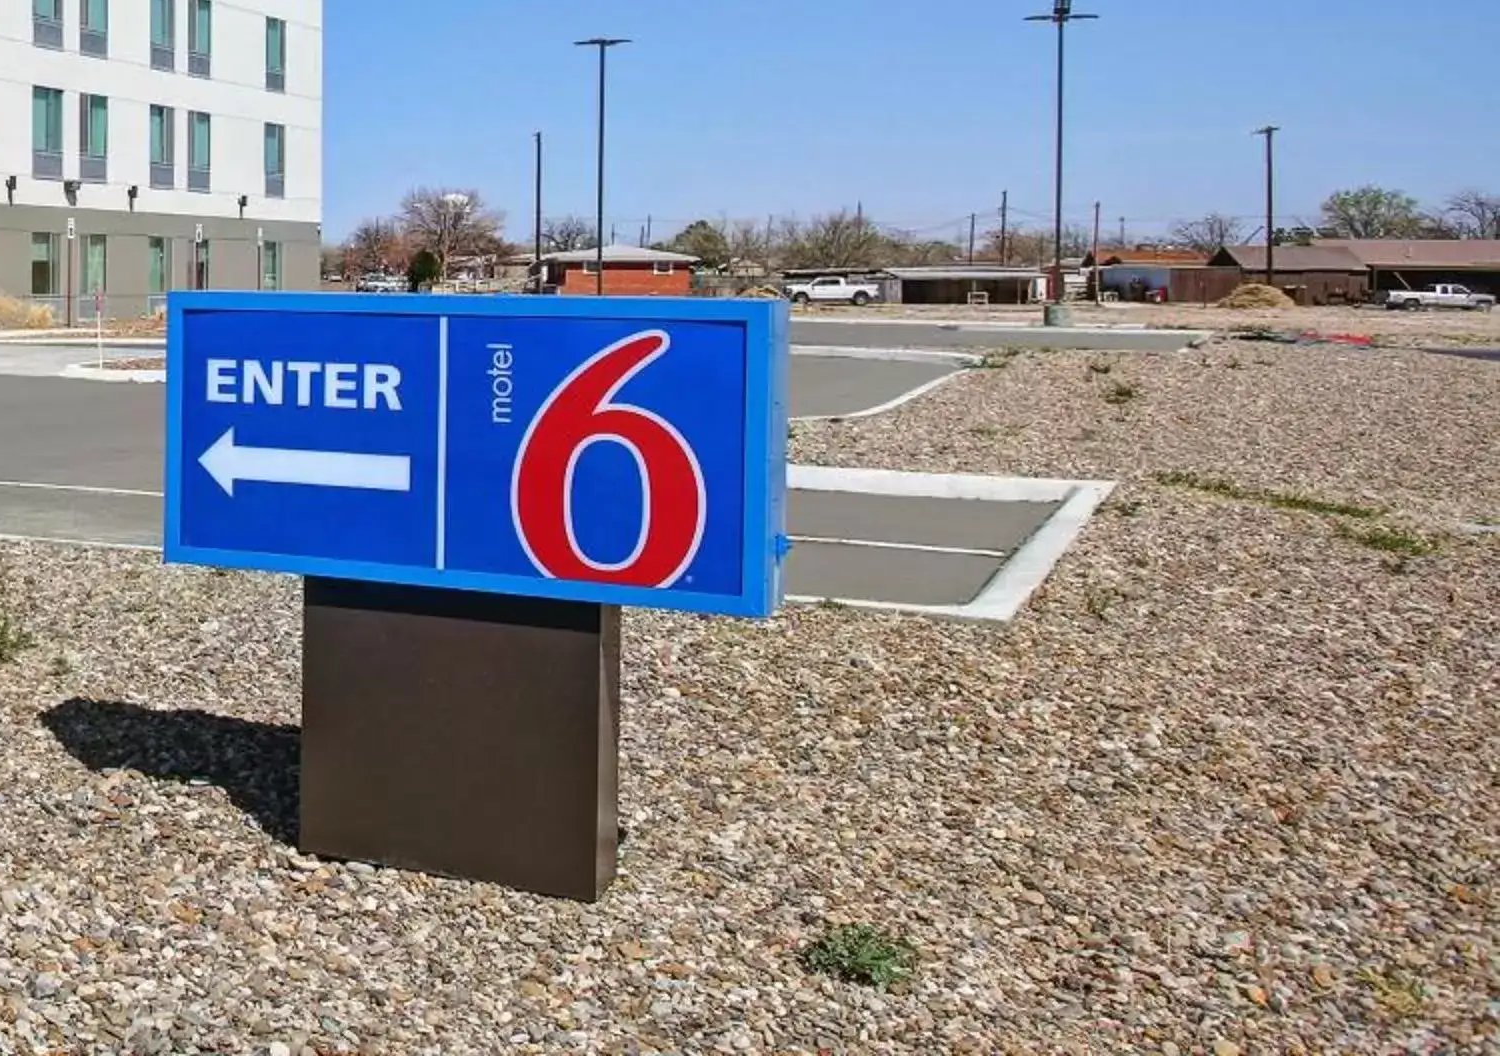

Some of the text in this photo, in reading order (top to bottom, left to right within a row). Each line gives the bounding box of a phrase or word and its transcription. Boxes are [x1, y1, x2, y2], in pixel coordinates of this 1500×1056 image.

[206, 358, 403, 412] ENTER
[486, 329, 708, 590] motel 6
